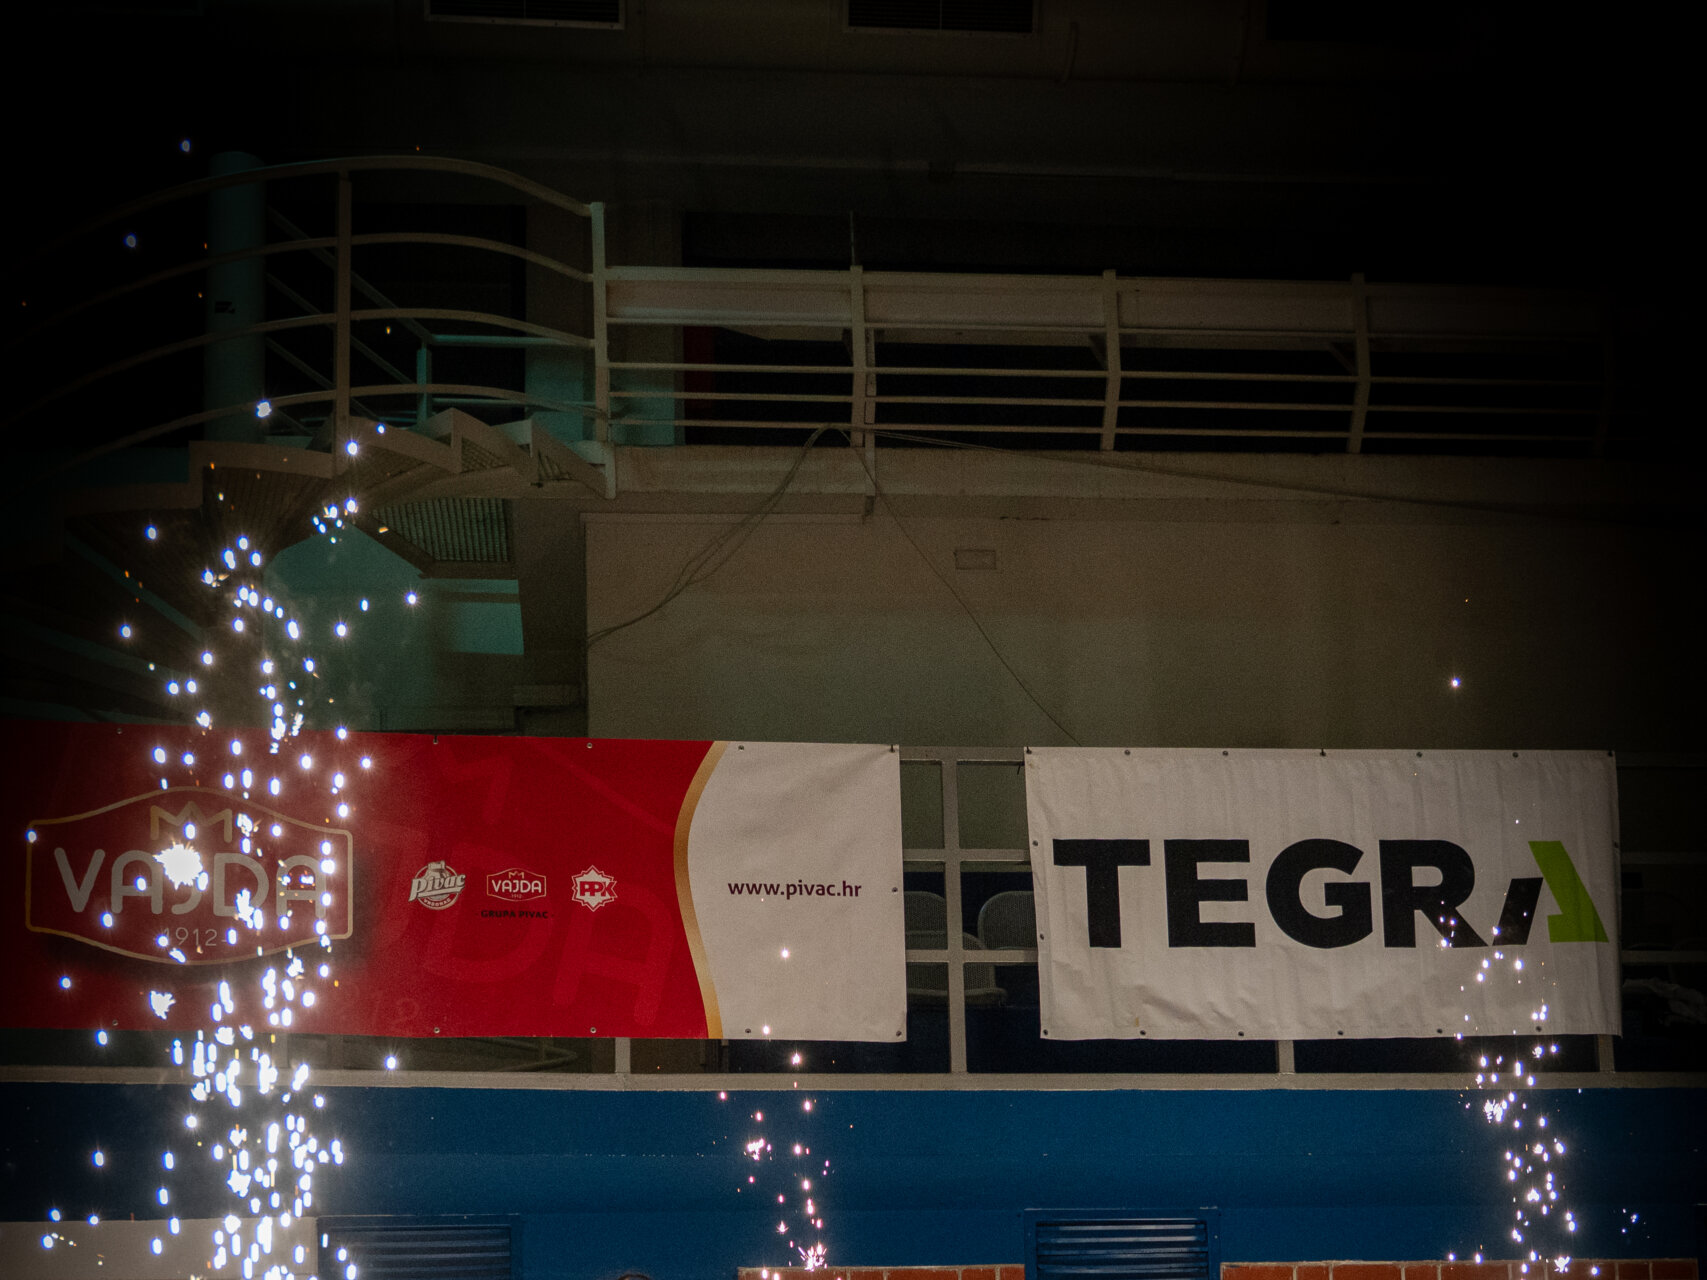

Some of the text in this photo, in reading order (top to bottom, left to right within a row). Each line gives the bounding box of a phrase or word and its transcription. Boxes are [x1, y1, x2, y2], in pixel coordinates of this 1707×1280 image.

[491, 879, 542, 894] VAJDA
[579, 880, 615, 897] PPK
[727, 879, 862, 900] www.pivac.hr
[1052, 838, 1609, 949] TEGRA
[480, 909, 549, 919] GRUPA PIVAC
